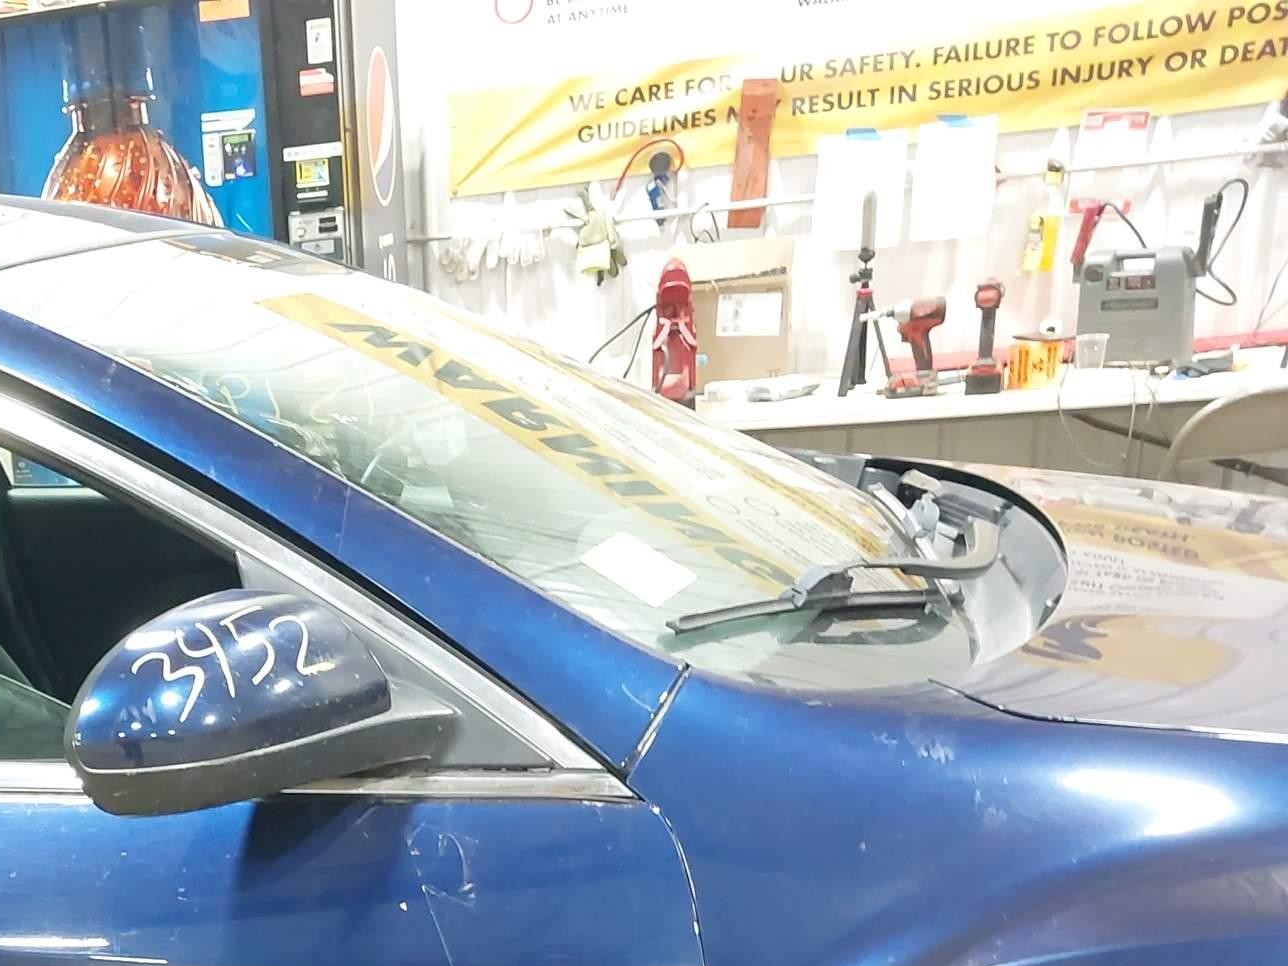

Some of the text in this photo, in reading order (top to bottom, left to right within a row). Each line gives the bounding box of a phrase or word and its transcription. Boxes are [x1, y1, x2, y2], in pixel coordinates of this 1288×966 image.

[569, 92, 605, 112] WE
[614, 81, 675, 107] CARE
[685, 74, 732, 97] FOR
[780, 63, 814, 83] UR
[824, 49, 921, 78] SAFETY.
[932, 35, 1035, 65] FAILURE
[1046, 29, 1082, 52] TO
[1093, 10, 1217, 47] FOLLOW
[578, 108, 716, 143] GUIDELINES
[791, 88, 880, 116] RESULT
[889, 84, 918, 104] IN
[928, 70, 1041, 101] SERIOUS
[1051, 55, 1155, 87] INJURY
[1164, 48, 1207, 72] OR
[131, 605, 335, 723] 3452
